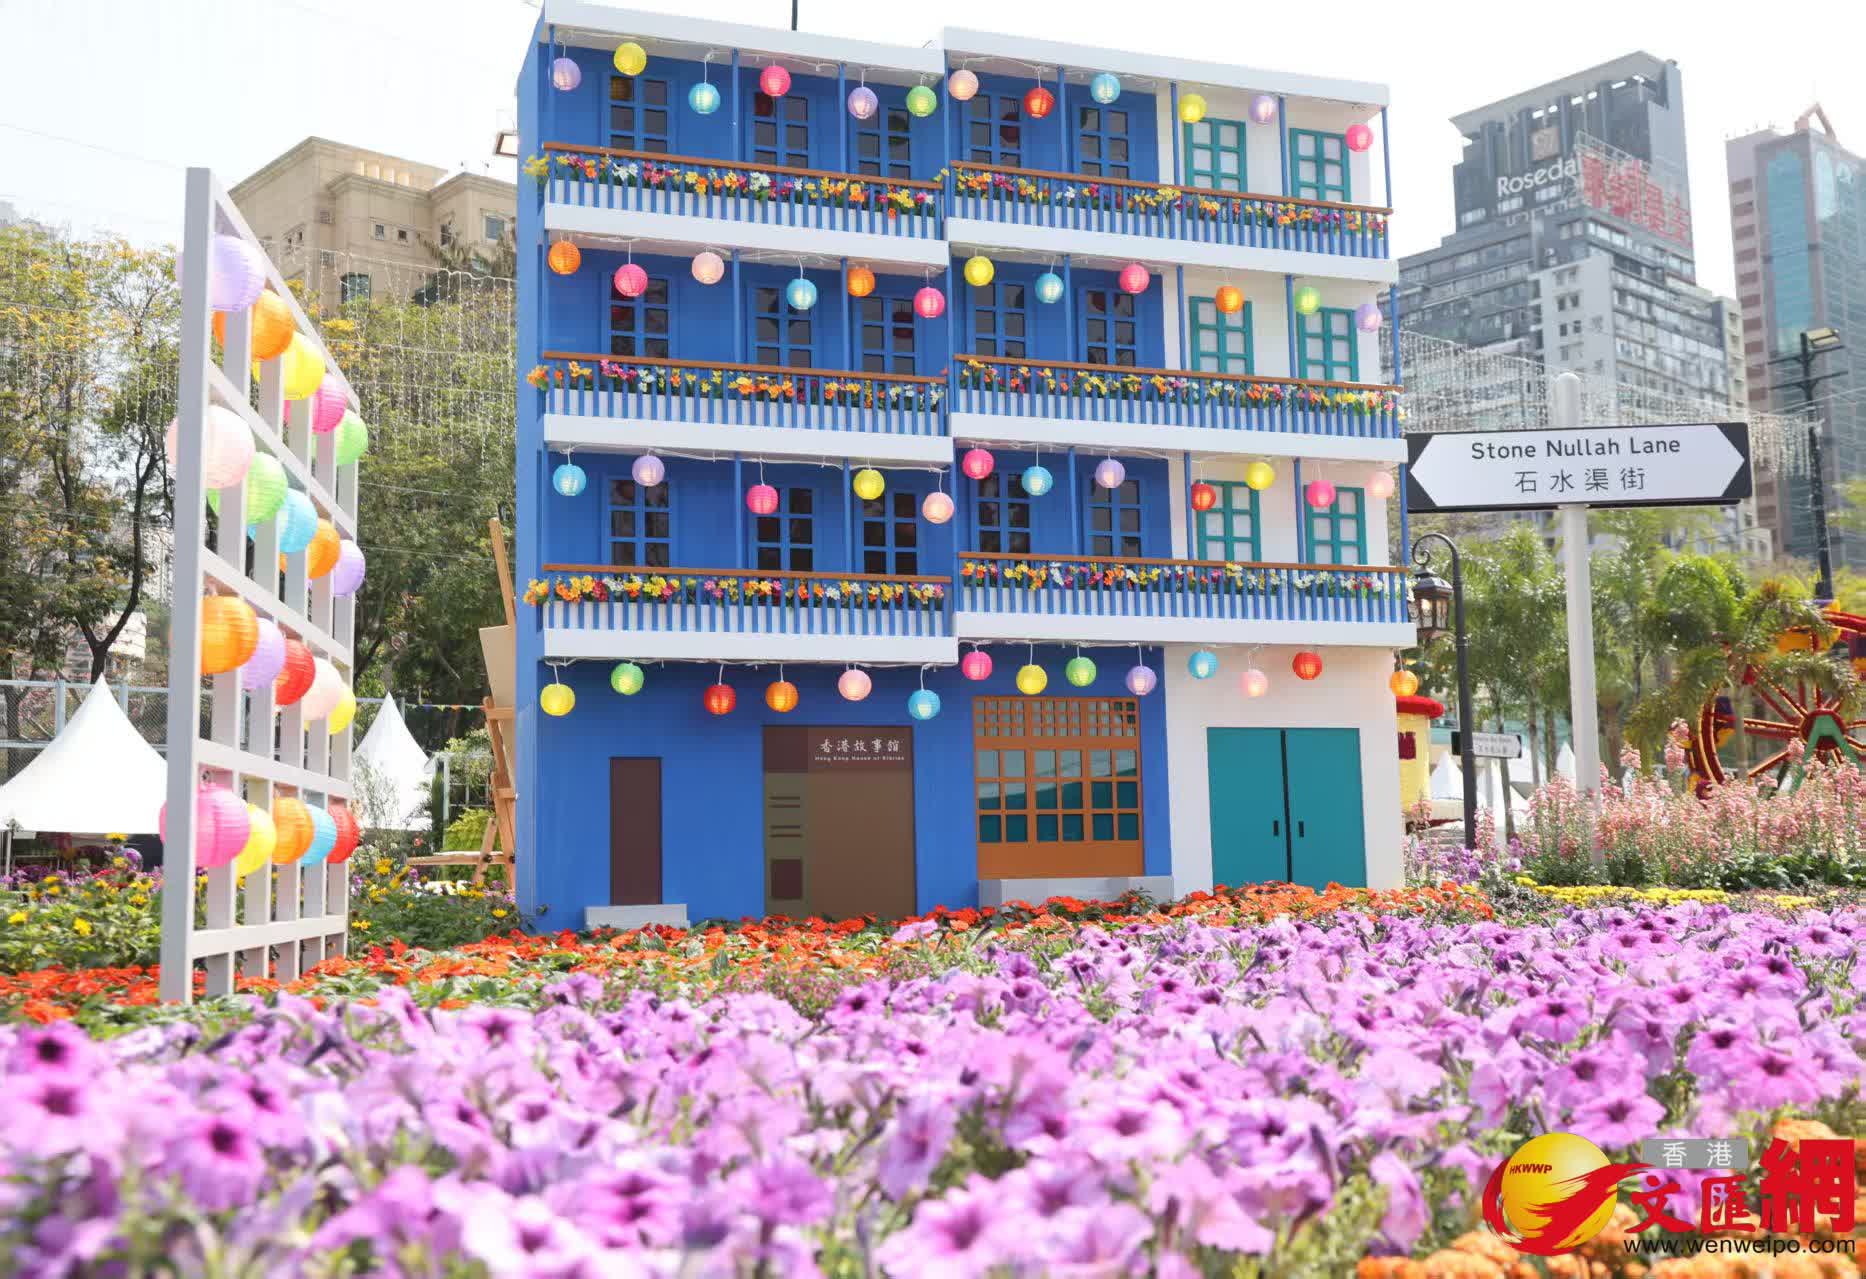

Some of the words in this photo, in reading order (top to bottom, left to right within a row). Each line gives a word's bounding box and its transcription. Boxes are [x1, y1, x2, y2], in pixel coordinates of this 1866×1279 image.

[1471, 442, 1536, 460] Stone
[1546, 438, 1620, 457] Nullah
[1630, 436, 1681, 454] Lane
[1514, 467, 1645, 493] 石水渠街
[821, 738, 900, 753] 香港故事館
